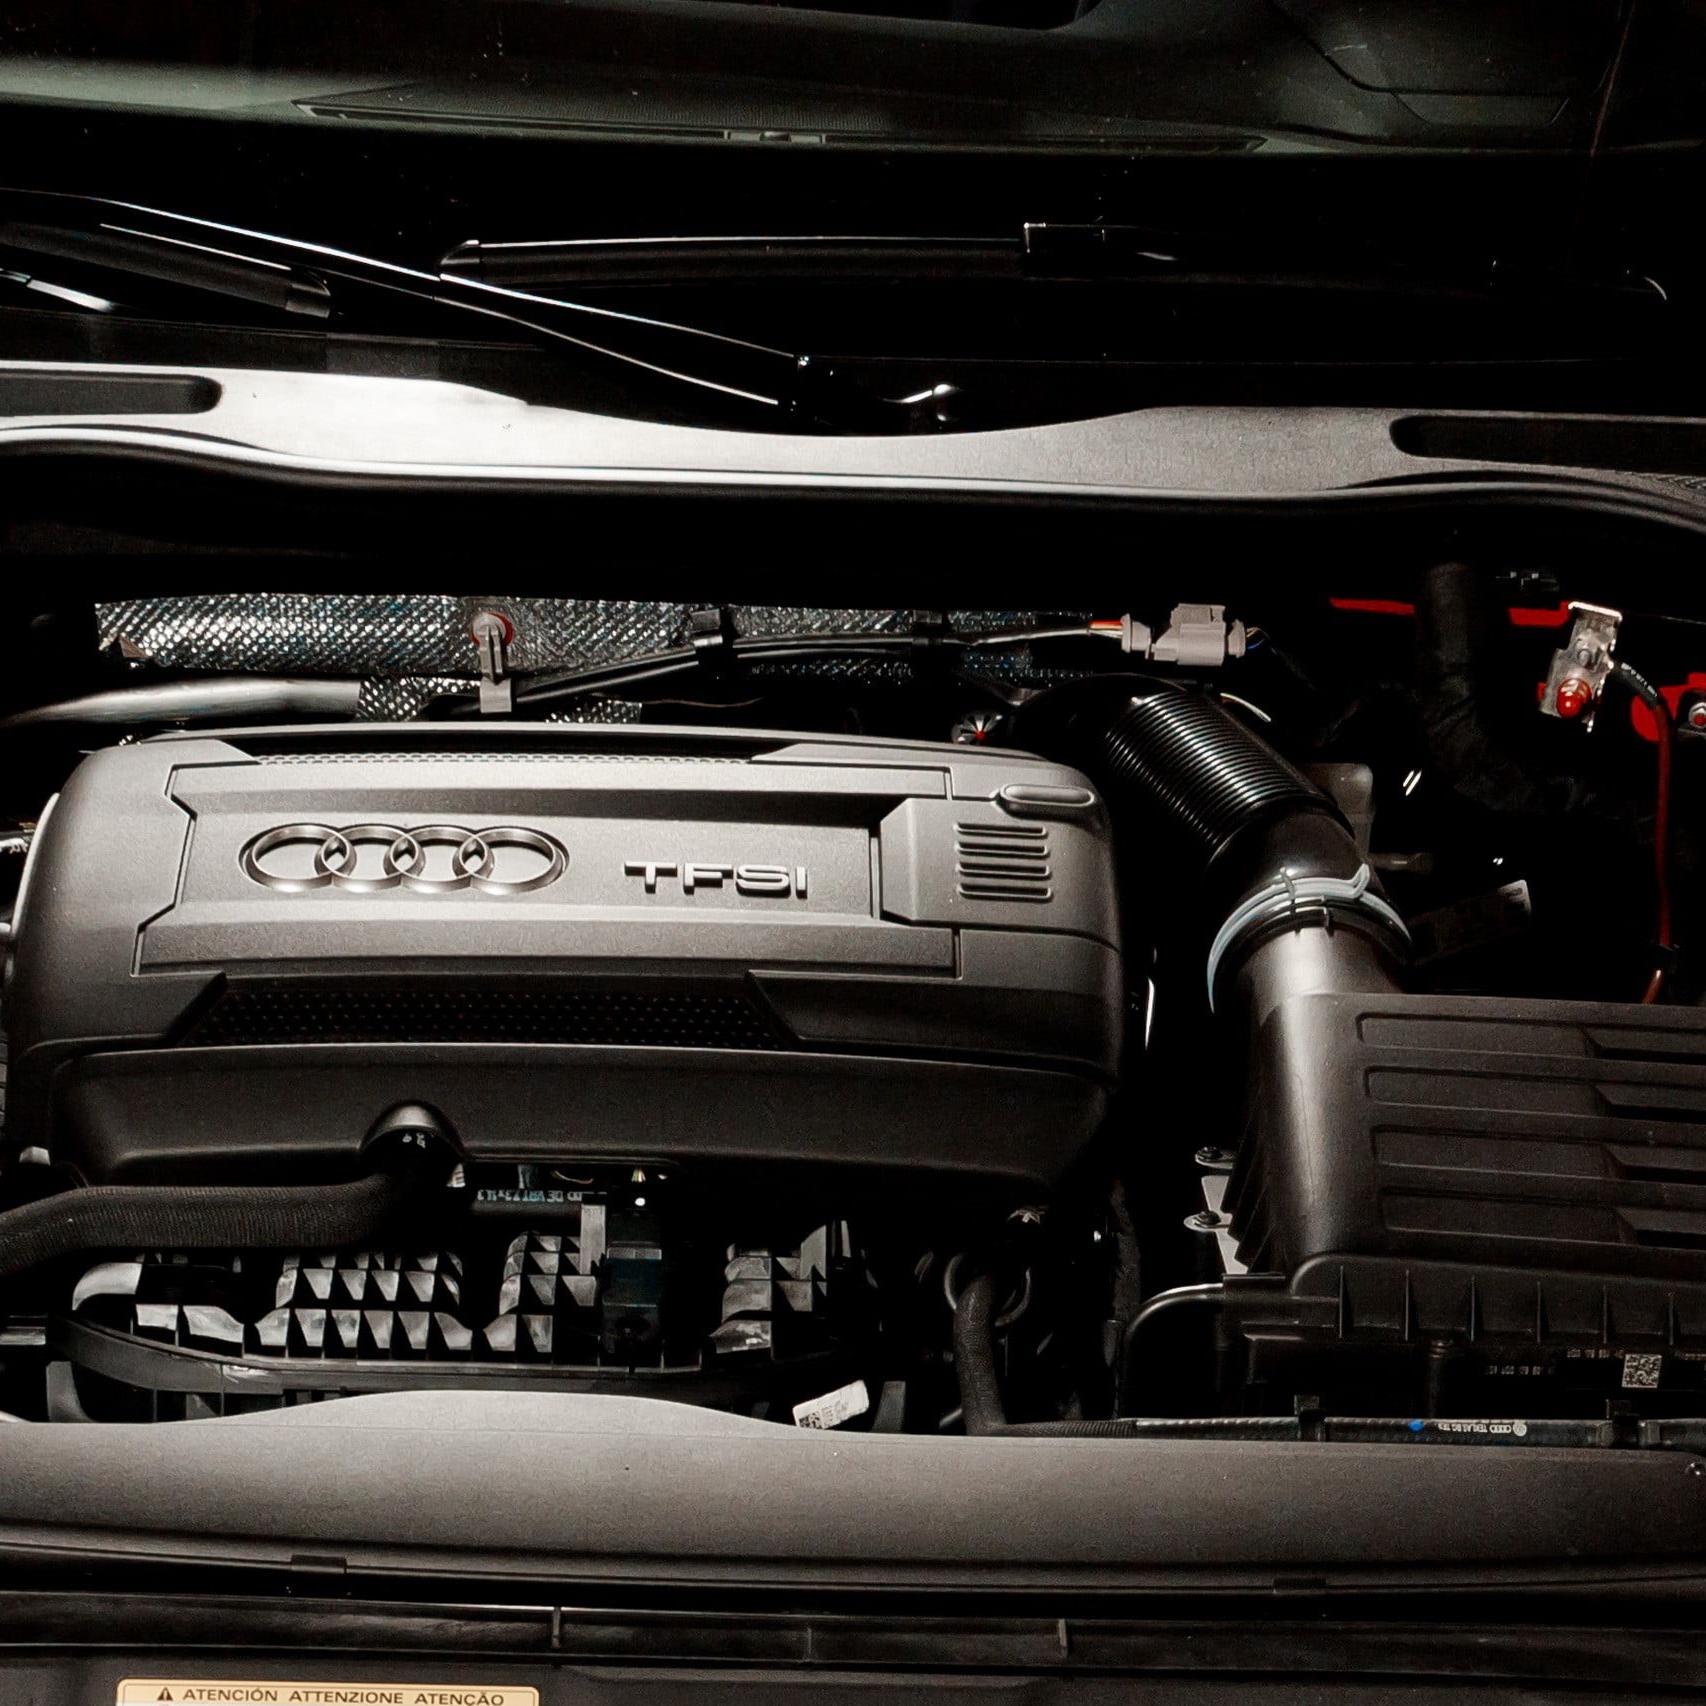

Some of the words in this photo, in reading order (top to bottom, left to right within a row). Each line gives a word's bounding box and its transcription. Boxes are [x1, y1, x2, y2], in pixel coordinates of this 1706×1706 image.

[624, 861, 808, 899] TFSI
[182, 1686, 278, 1702] ATENCIÓN
[289, 1689, 404, 1704] ATTENZIONE
